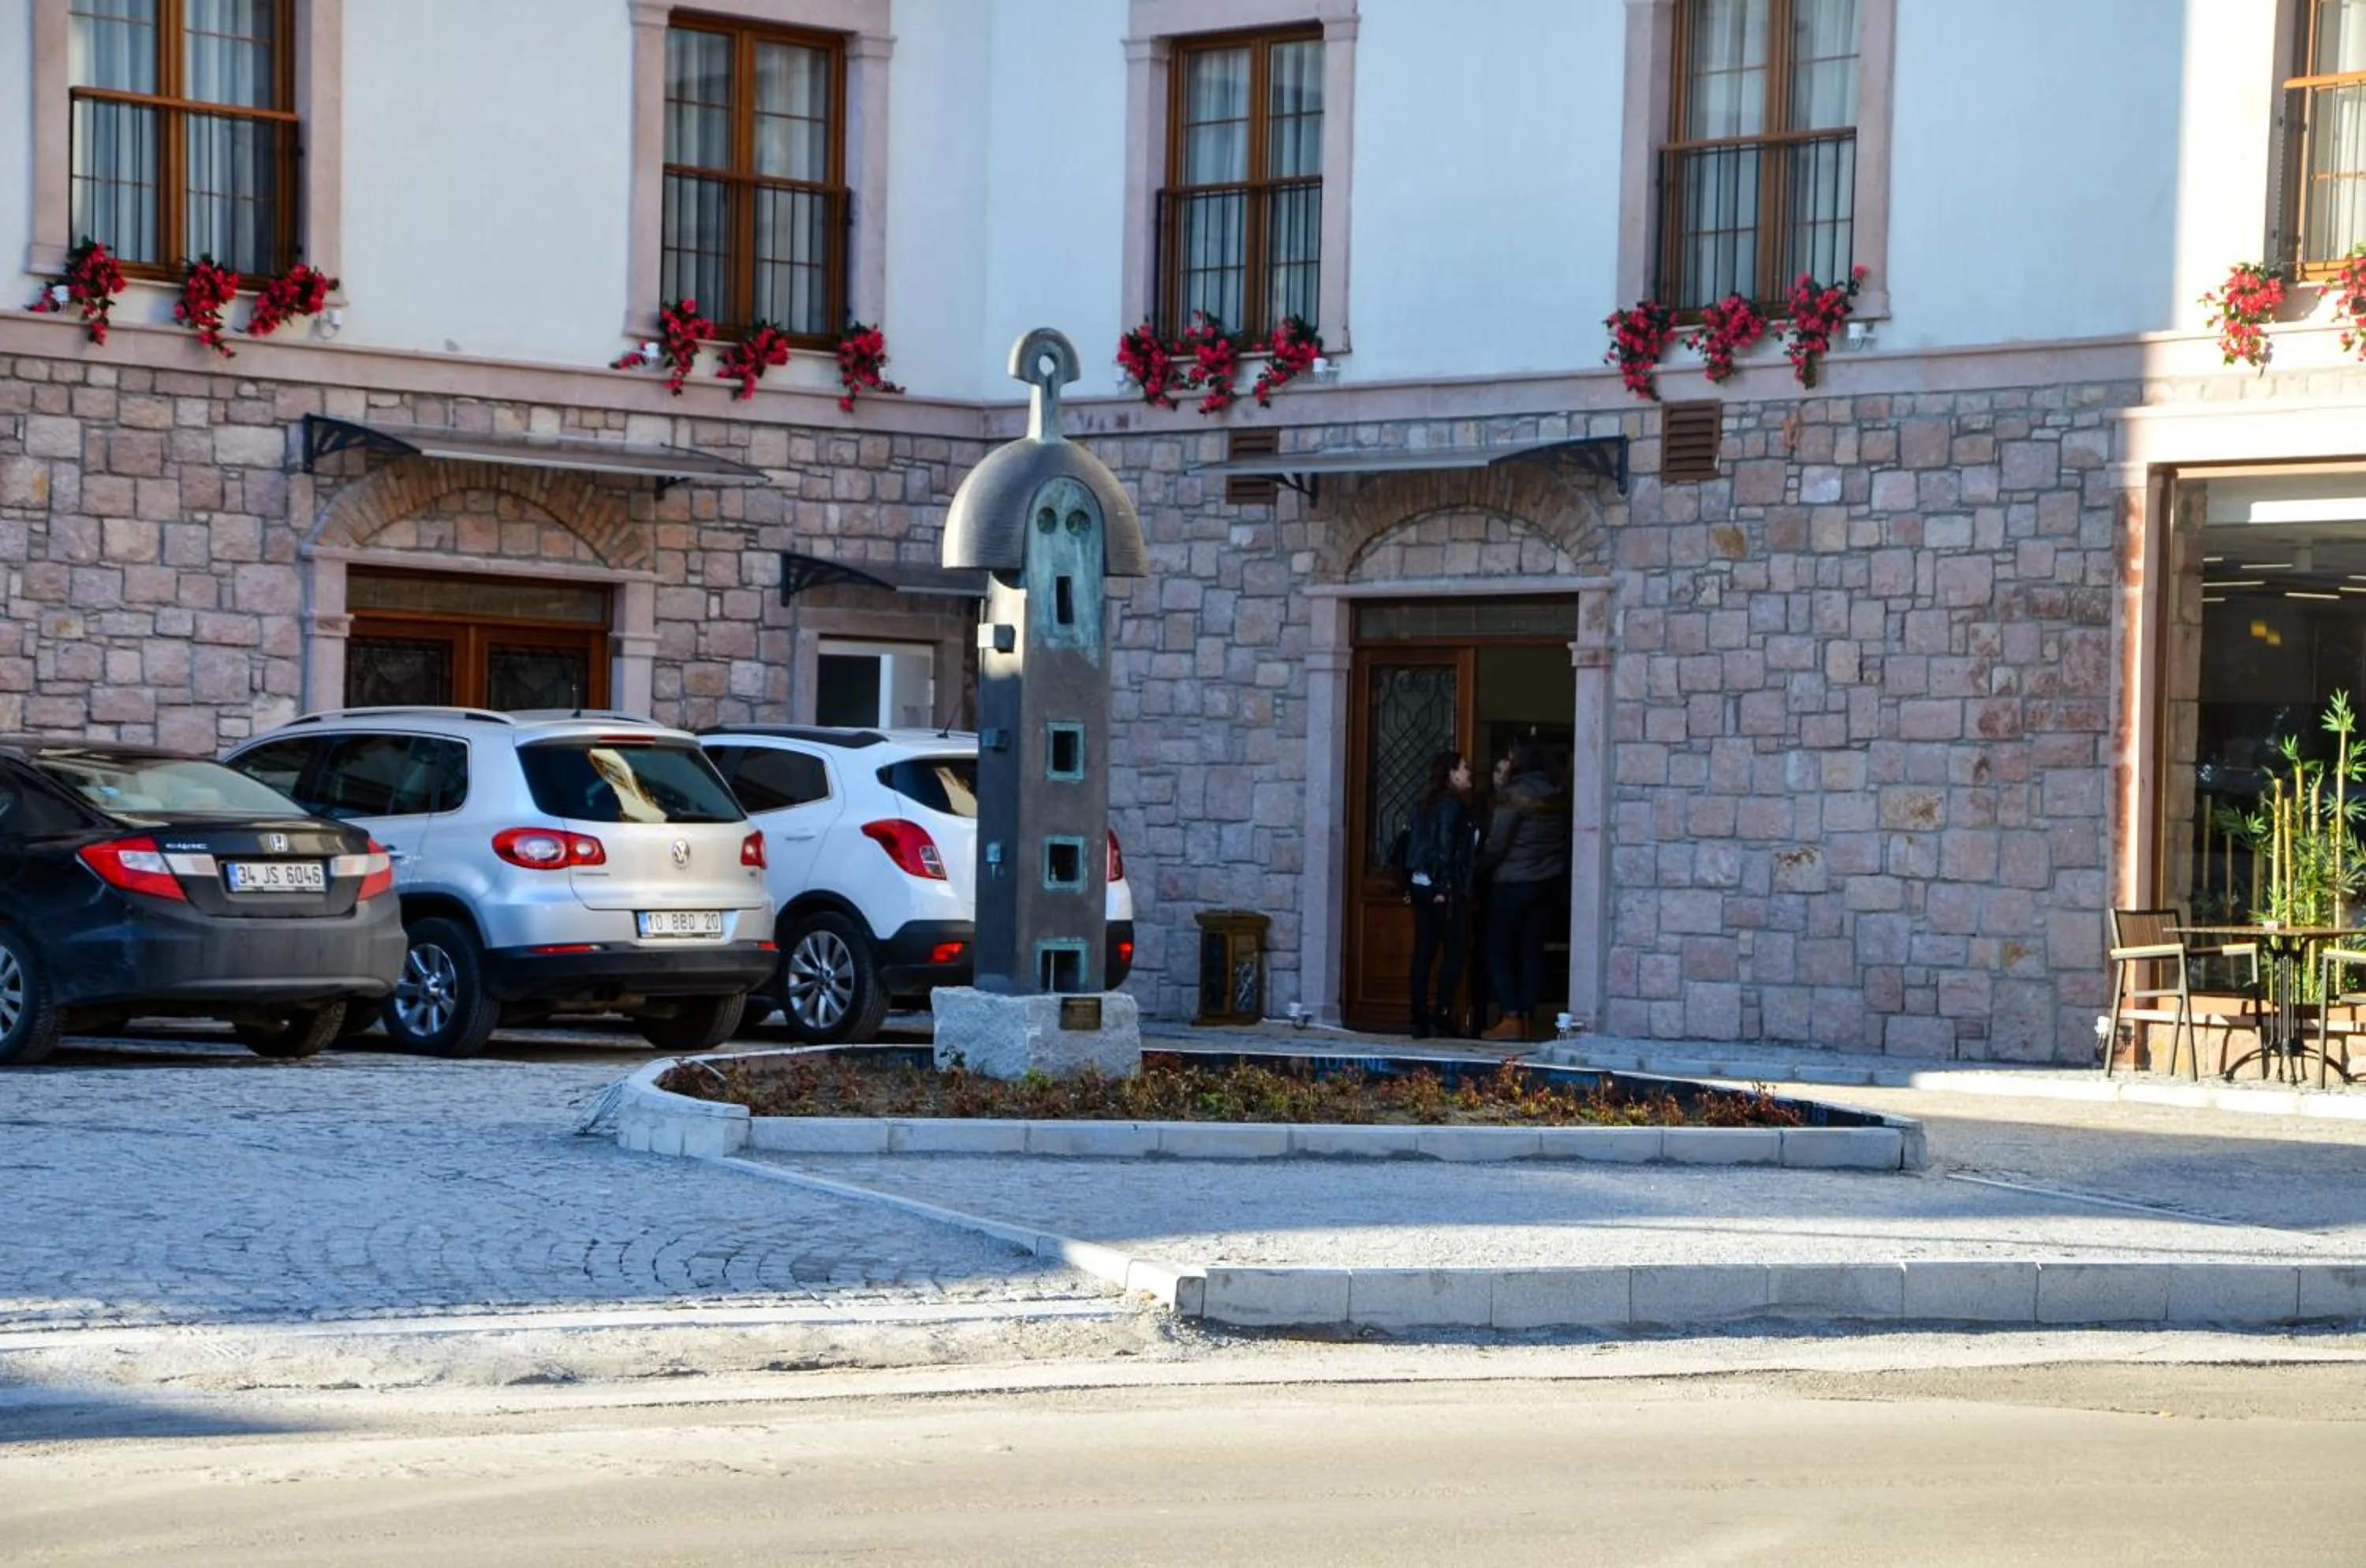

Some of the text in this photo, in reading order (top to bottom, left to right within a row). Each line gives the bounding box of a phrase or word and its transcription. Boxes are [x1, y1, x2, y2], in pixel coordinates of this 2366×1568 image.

[238, 865, 320, 883] 34 JS 6046
[647, 913, 662, 931] 10
[704, 913, 718, 930] 20
